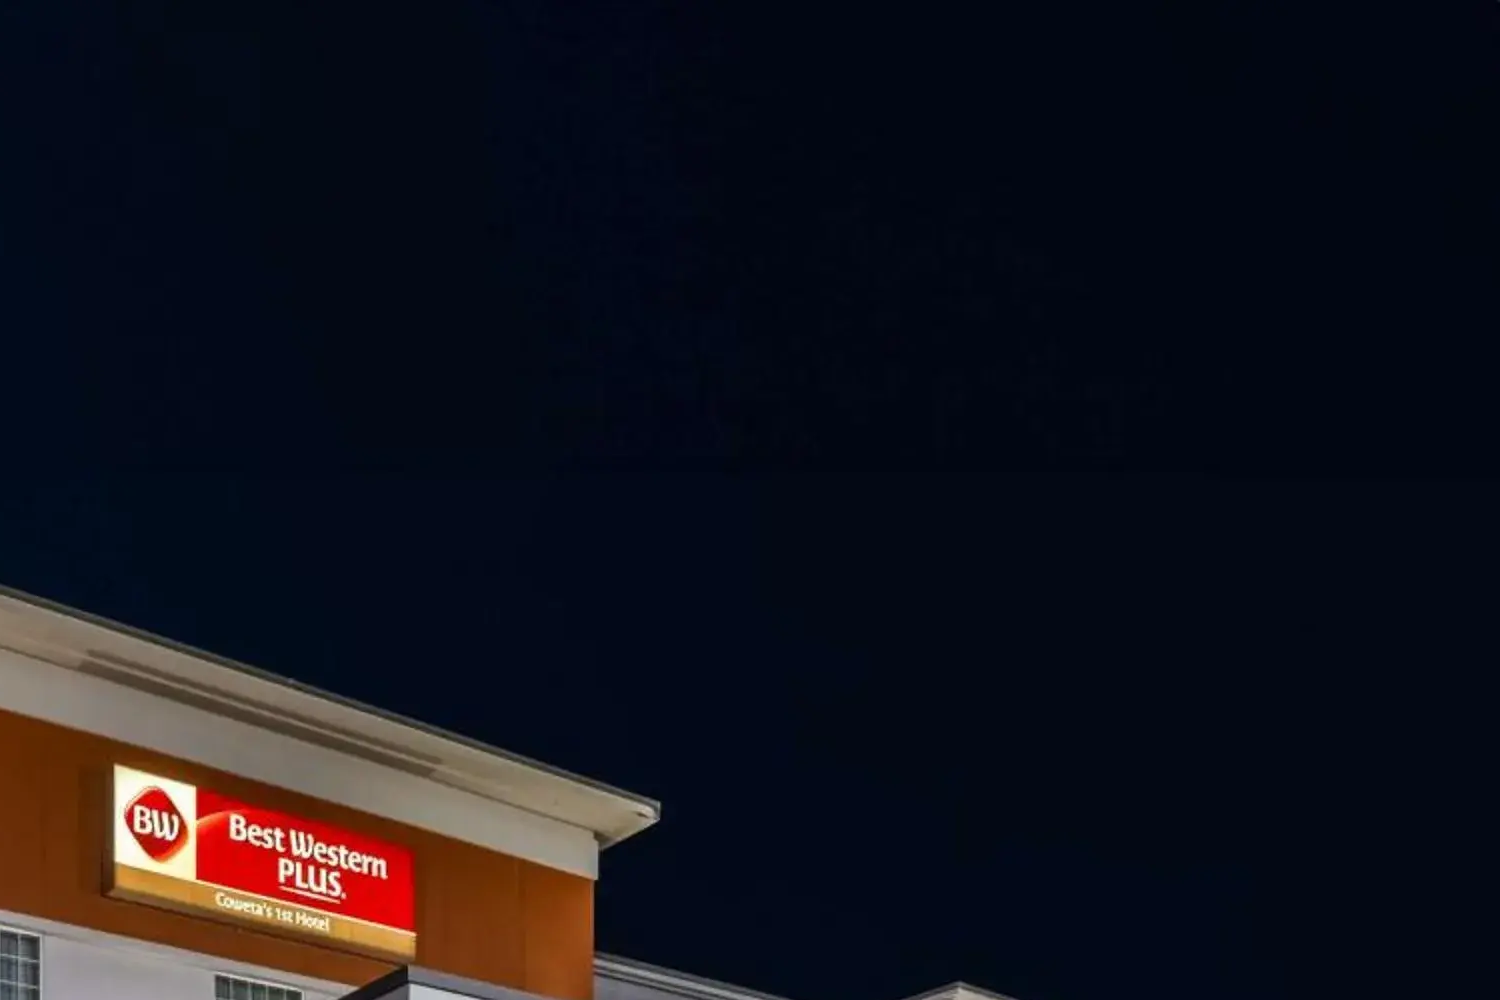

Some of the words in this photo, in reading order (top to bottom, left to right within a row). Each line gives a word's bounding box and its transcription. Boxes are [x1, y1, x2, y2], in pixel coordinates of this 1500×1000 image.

[133, 804, 180, 842] BW
[229, 813, 286, 853] Best
[289, 828, 388, 880] Western
[215, 892, 273, 919] Coweta's
[275, 907, 293, 923] 1st
[295, 911, 330, 932] Hotel
